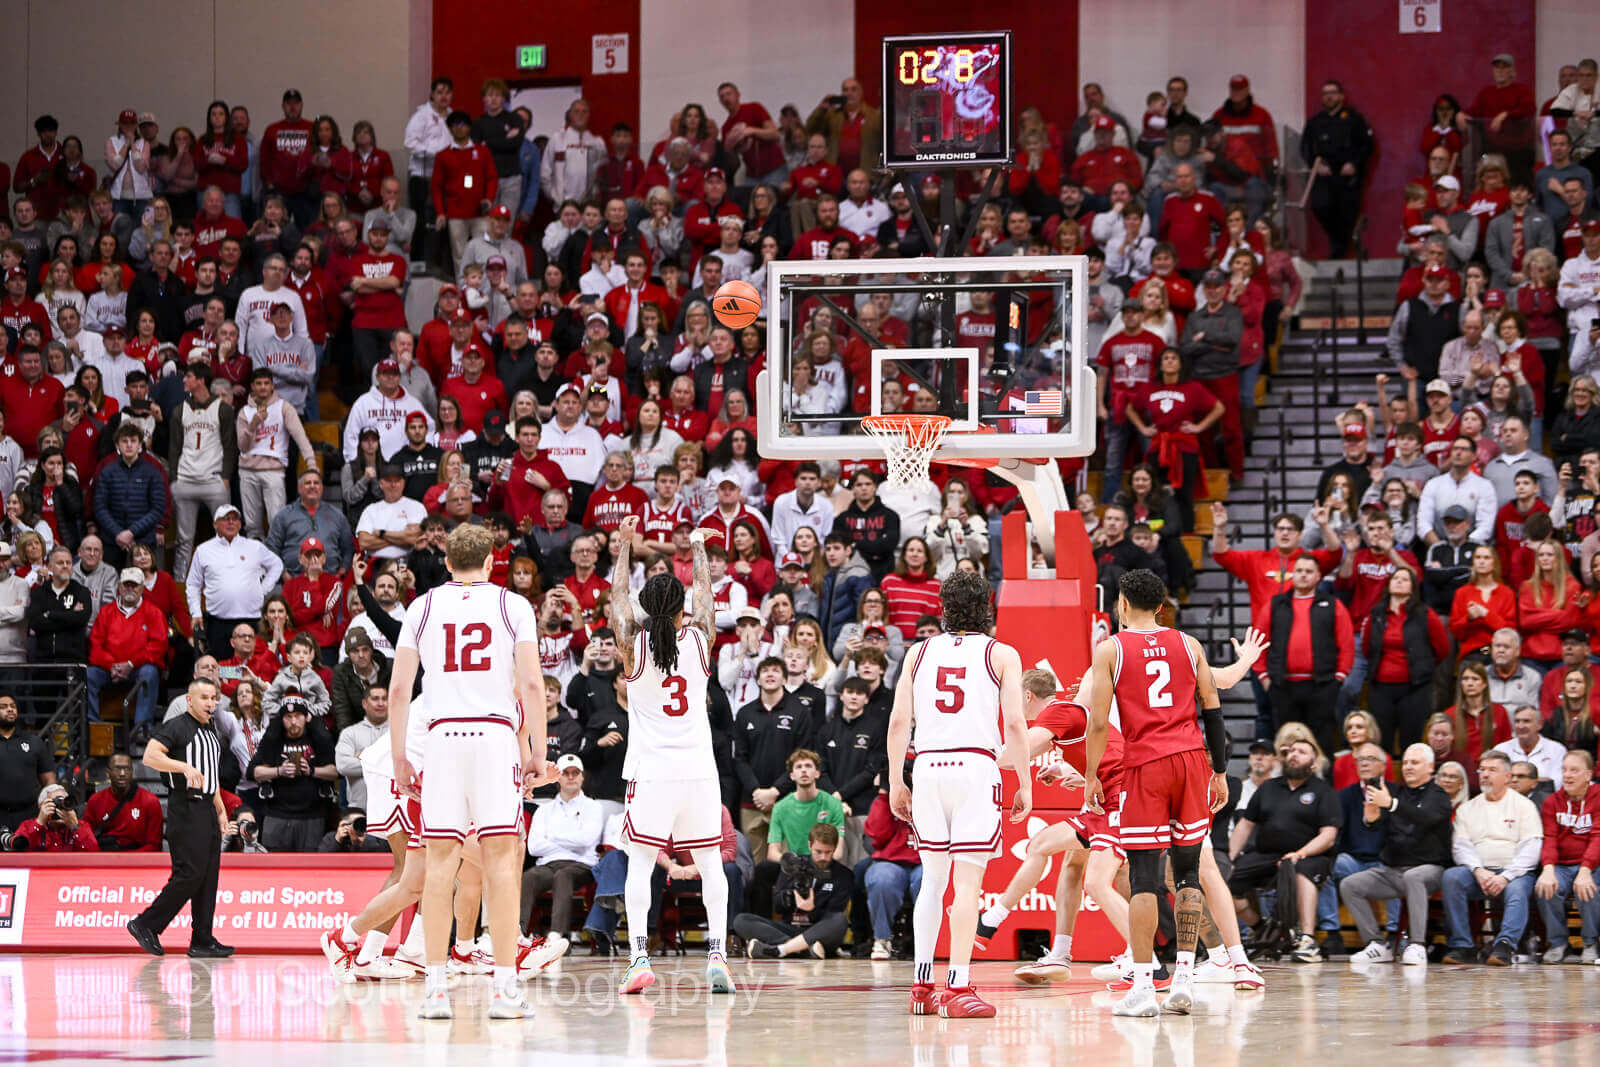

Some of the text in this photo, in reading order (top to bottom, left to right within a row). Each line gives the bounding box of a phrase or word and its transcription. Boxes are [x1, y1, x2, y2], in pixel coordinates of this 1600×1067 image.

[1413, 6, 1427, 27] 6
[604, 49, 616, 69] 5
[915, 152, 977, 161] DAKTRONICS
[195, 432, 201, 451] 1
[594, 502, 632, 516] INDIANA
[442, 622, 492, 673] 12
[1143, 646, 1167, 658] BOYD
[935, 666, 966, 714] 5
[1145, 660, 1173, 708] 2
[661, 675, 689, 717] 3
[57, 886, 124, 903] Official
[239, 887, 275, 904] and
[281, 887, 344, 909] Sports
[231, 912, 252, 928] of
[257, 912, 278, 928] IU
